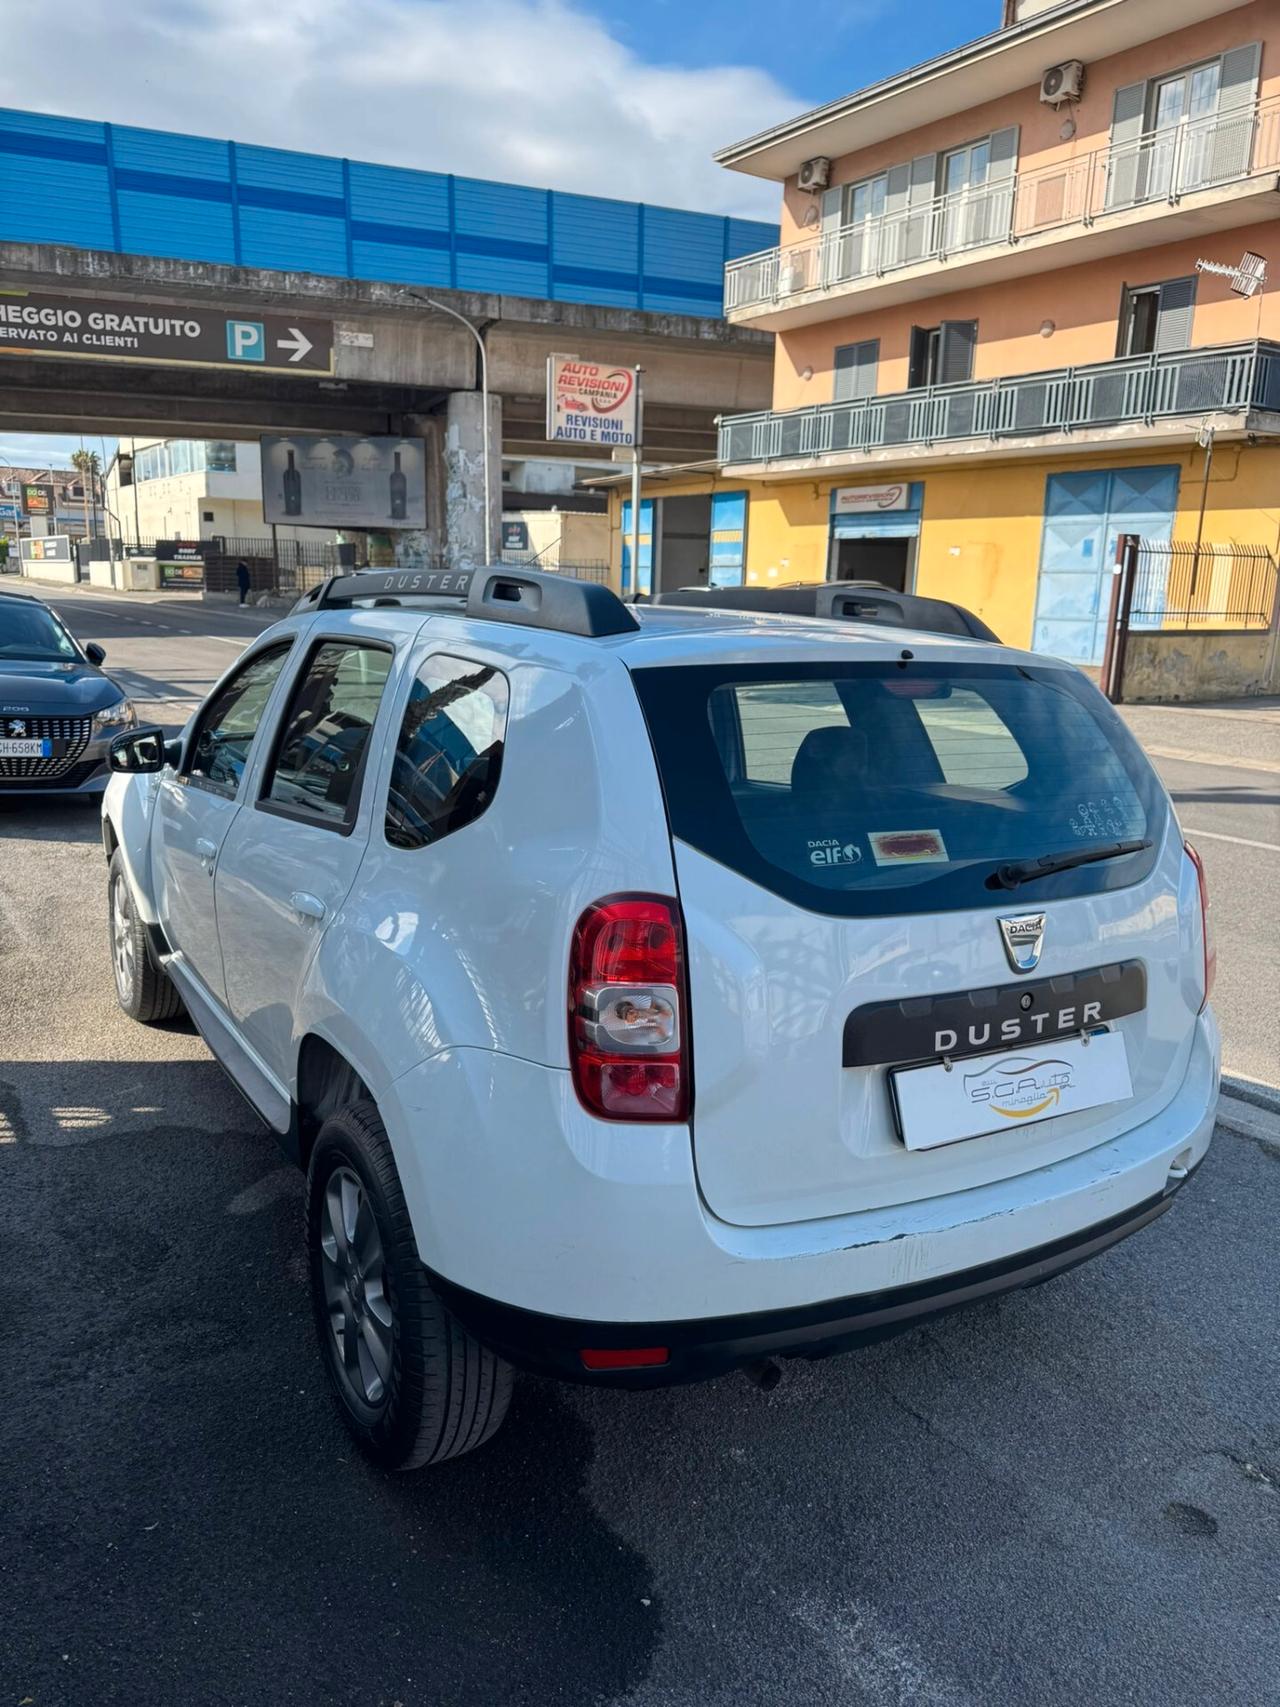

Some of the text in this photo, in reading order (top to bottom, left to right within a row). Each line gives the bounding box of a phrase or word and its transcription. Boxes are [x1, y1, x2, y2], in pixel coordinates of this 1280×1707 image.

[88, 312, 201, 338] GRATUITO
[0, 327, 139, 348] ERVATO AI CLIENTI
[234, 324, 259, 356] P
[561, 363, 599, 376] AUTO
[558, 375, 625, 392] REVISIONI
[578, 388, 618, 399] CAMPANIA
[566, 414, 623, 431] REVISIONI
[556, 426, 632, 444] AUTO E MOTO
[384, 575, 469, 590] DUSTER
[808, 839, 839, 848] DACIA
[810, 847, 842, 864] elf
[1010, 922, 1042, 934] DACIA
[935, 1001, 1102, 1051] DUSTER
